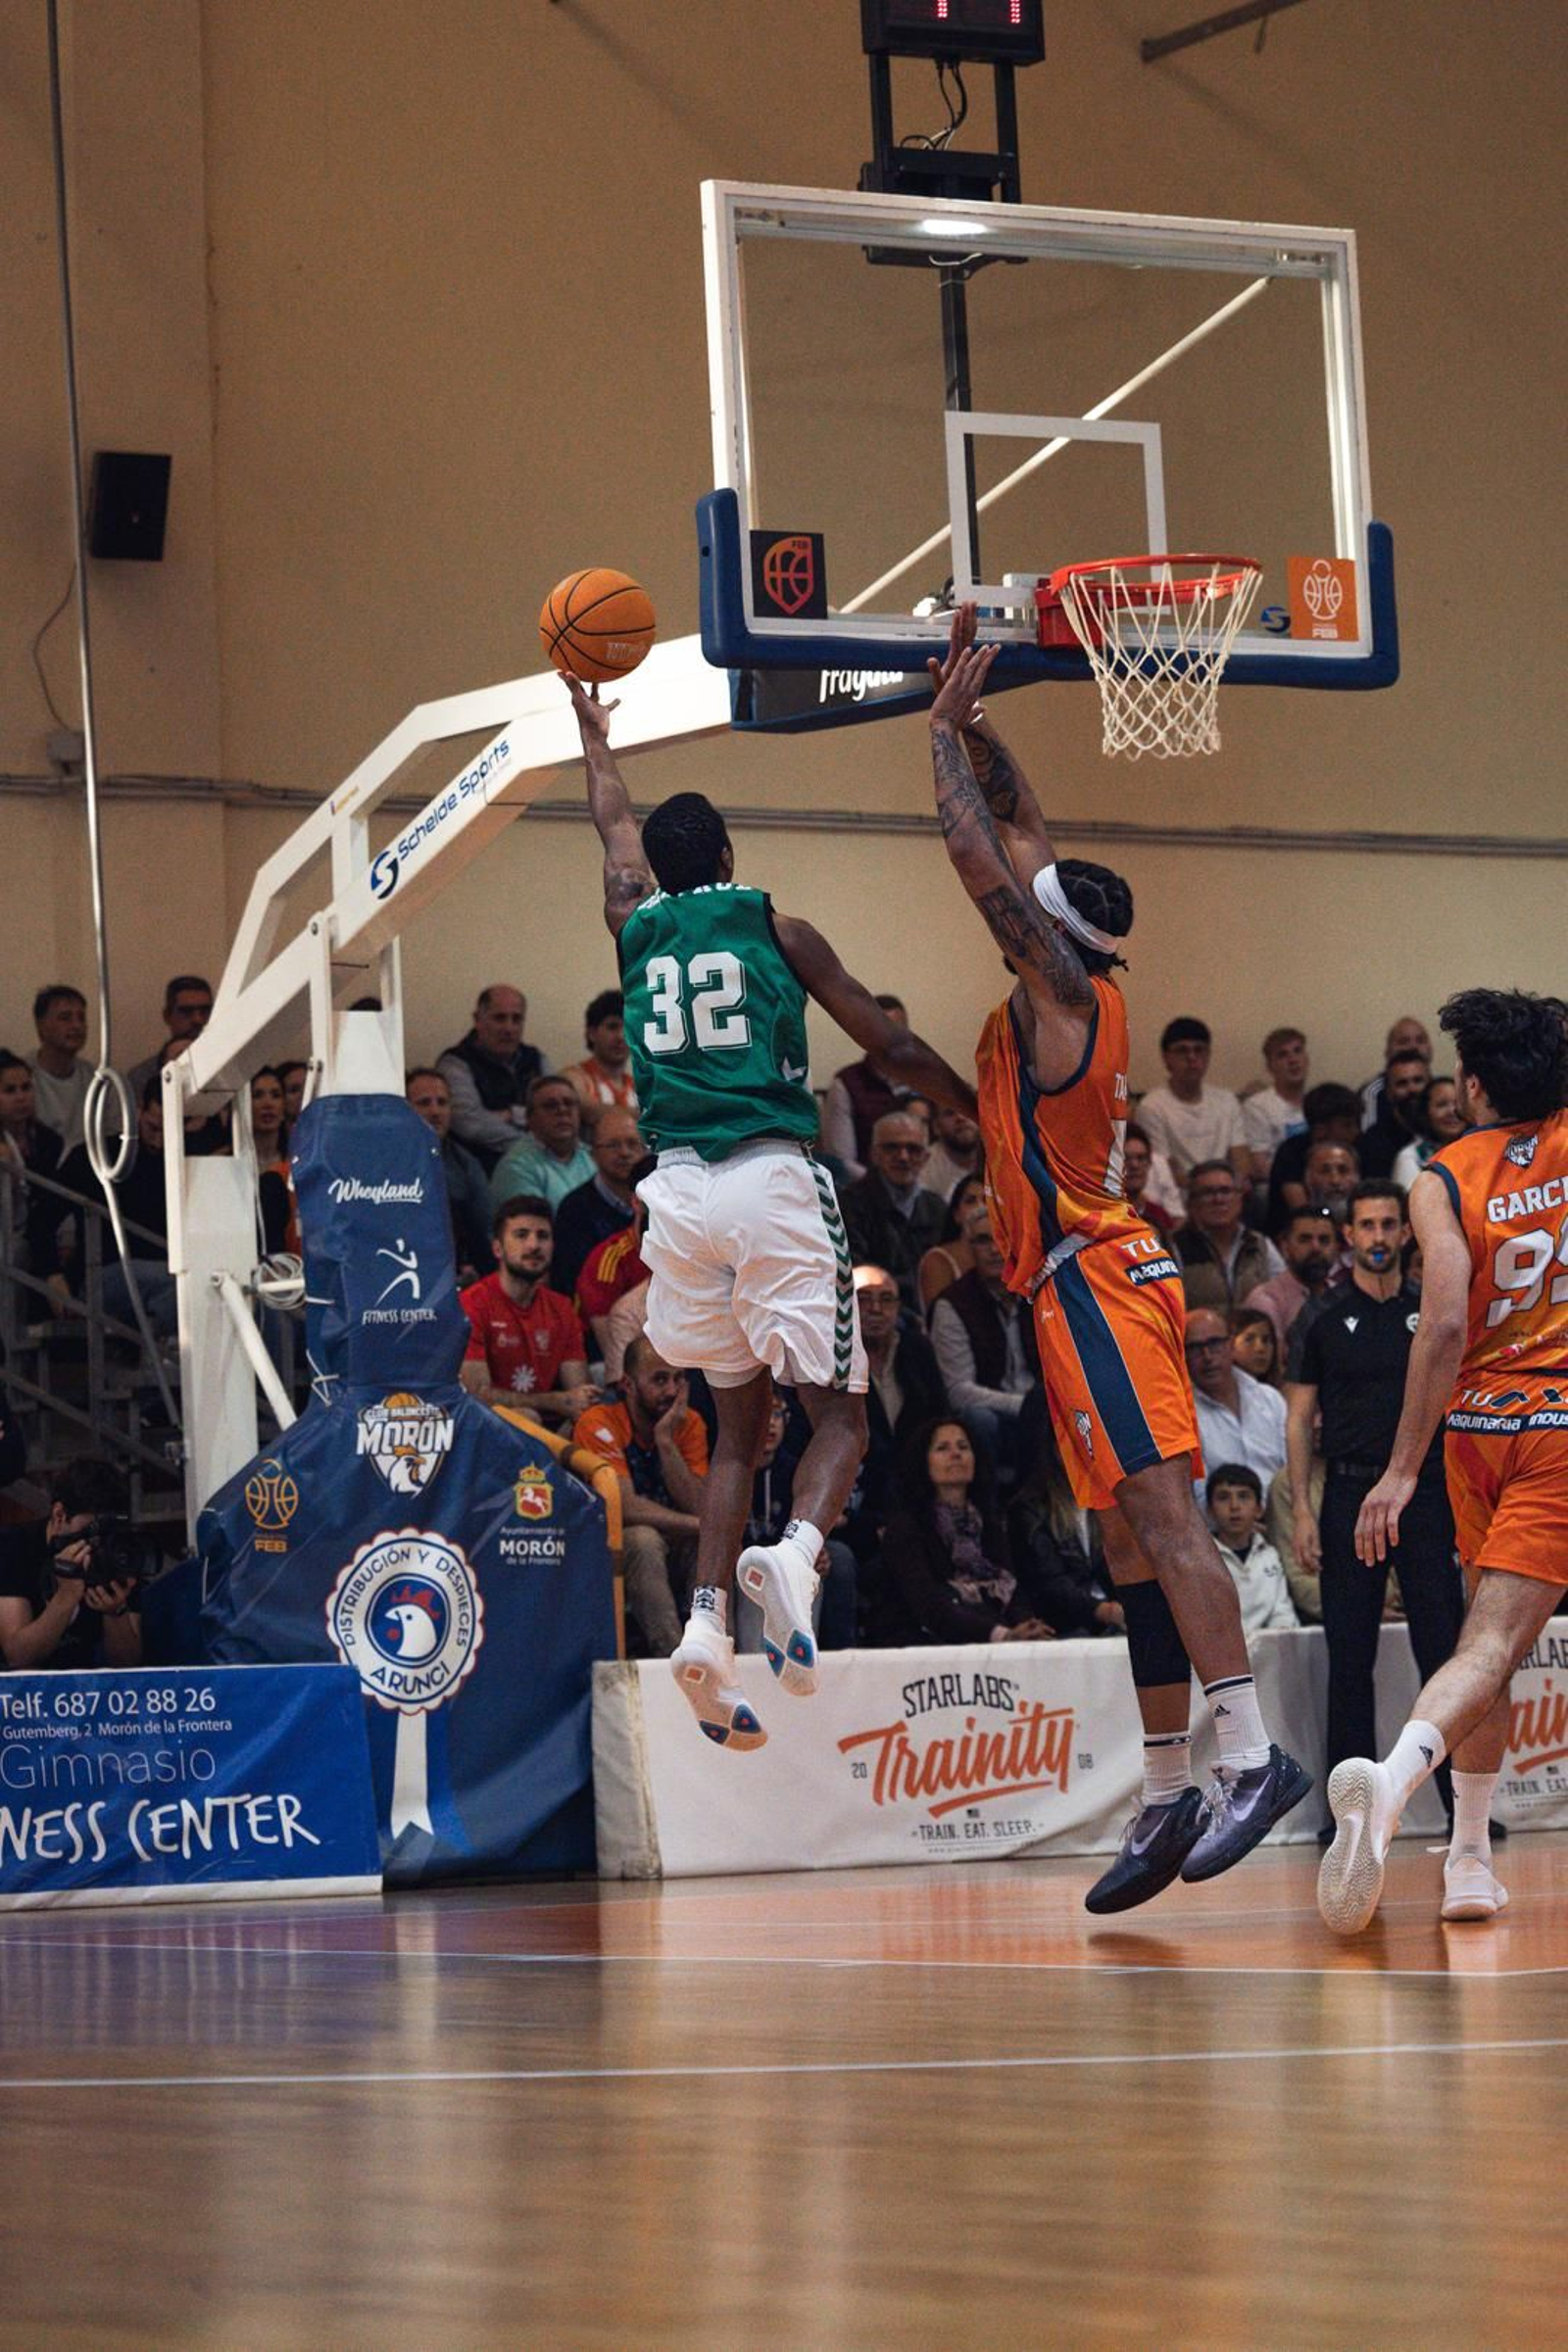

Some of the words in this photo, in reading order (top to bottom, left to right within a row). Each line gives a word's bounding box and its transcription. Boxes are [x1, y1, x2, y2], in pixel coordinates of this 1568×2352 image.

[398, 792, 459, 861] Schelde
[459, 740, 511, 800] Sports
[644, 952, 753, 1056] 32
[327, 1177, 424, 1204] Wheyland
[499, 1536, 565, 1556] MORÓN
[339, 1546, 412, 1646] DISTRIBUCIÓN
[417, 1548, 430, 1564] Y
[435, 1556, 471, 1647] DESPIECES
[369, 1660, 451, 1695] ARUNCI
[902, 1673, 1015, 1719] STARLABS
[0, 1691, 49, 1719] Telf.
[54, 1691, 101, 1717] 687
[108, 1690, 140, 1715] 02
[146, 1689, 178, 1714] 88
[183, 1687, 217, 1713] 26
[3, 1725, 82, 1740] Gutemberg,
[84, 1724, 93, 1738] 2
[98, 1722, 141, 1736] Morón
[144, 1721, 162, 1735] de
[164, 1720, 176, 1734] la
[177, 1718, 233, 1733] Frontera
[0, 1739, 217, 1789] Gimnasio
[837, 1700, 1075, 1807] Trainity
[851, 1762, 868, 1780] 20
[128, 1793, 320, 1862] CENTER
